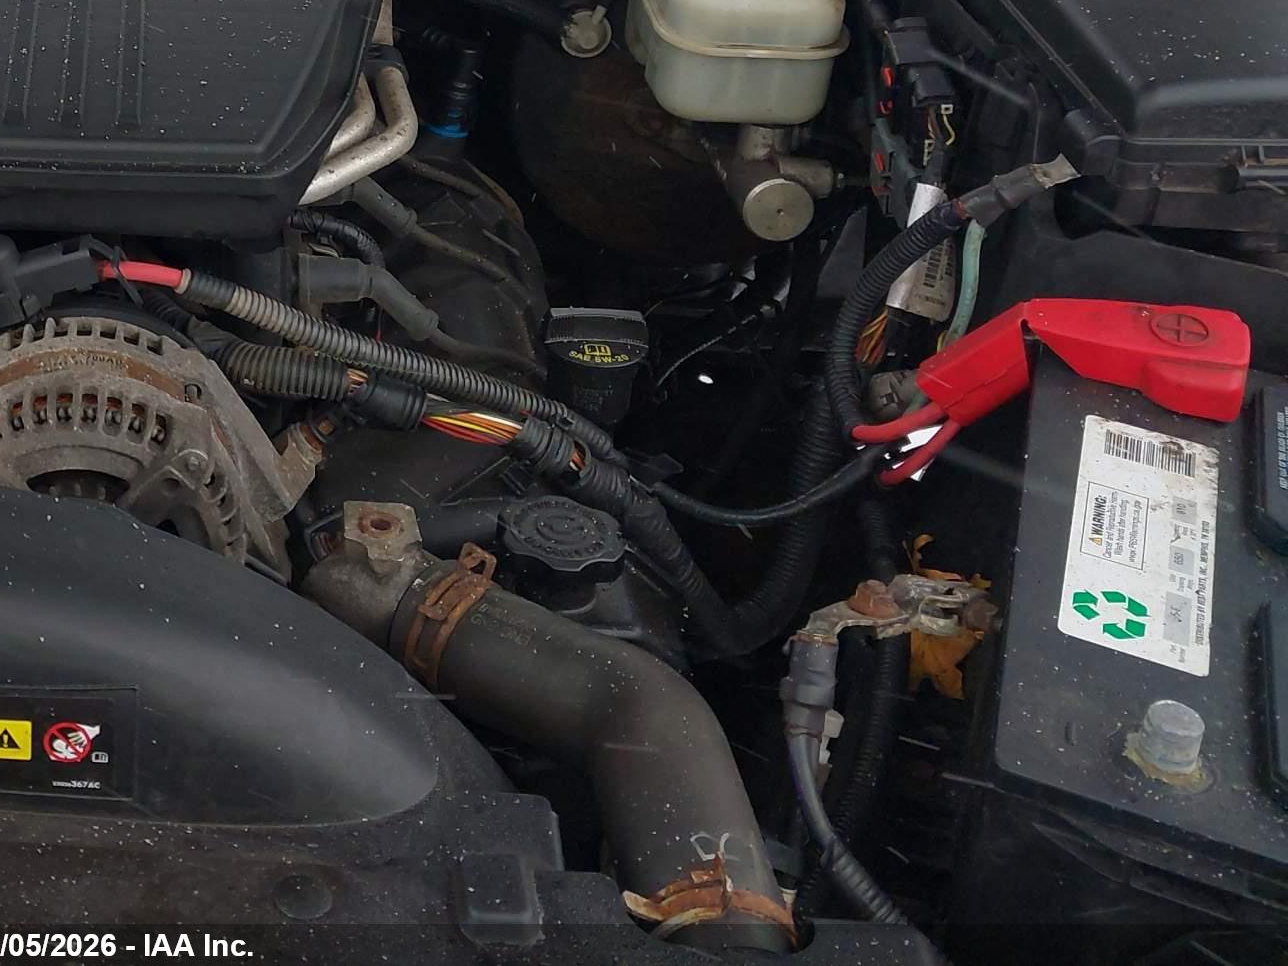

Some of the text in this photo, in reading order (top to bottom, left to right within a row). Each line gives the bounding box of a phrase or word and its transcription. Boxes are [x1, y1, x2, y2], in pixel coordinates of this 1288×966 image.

[568, 349, 630, 363] SAE 5W-20
[1091, 495, 1107, 536] WARNING:
